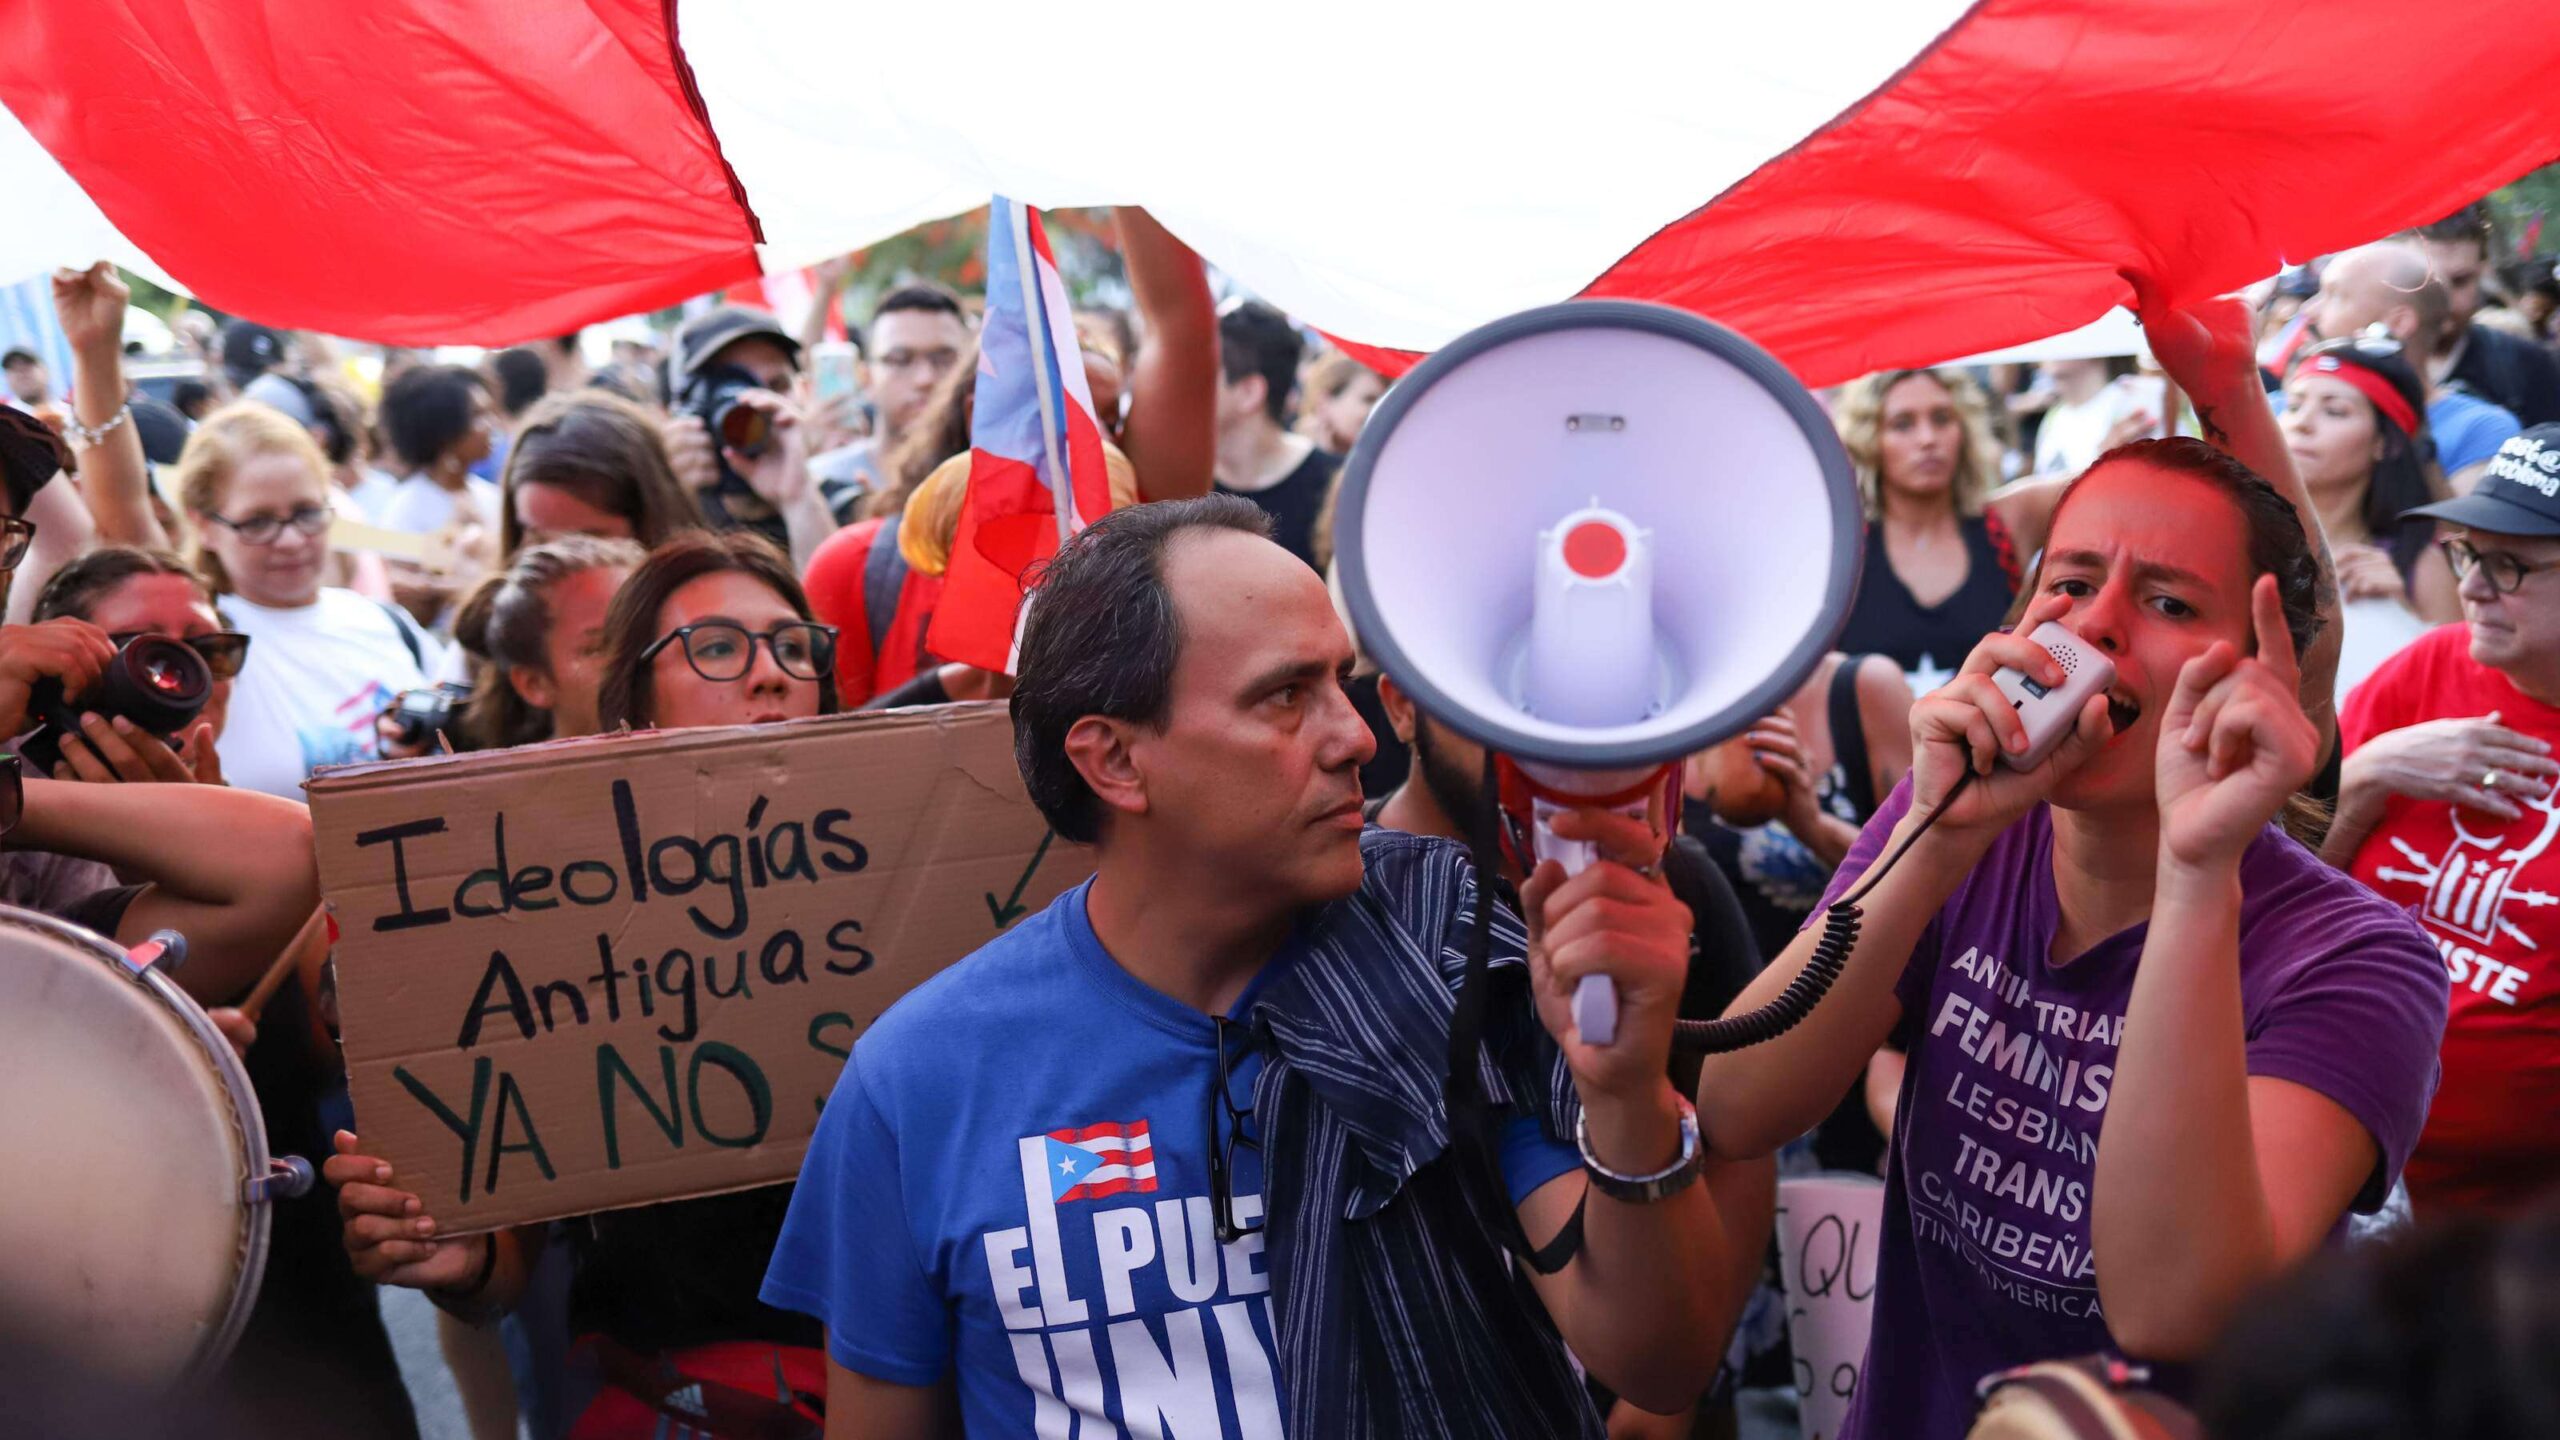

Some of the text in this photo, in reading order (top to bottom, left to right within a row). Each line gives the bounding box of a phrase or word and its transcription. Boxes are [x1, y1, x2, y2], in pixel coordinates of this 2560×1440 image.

[355, 779, 869, 939] Ideologías
[457, 920, 875, 1048] Antiguas
[394, 1056, 556, 1203] YA
[597, 1040, 773, 1170] NO
[1953, 1133, 2086, 1222] TRANS
[983, 1134, 1090, 1330] EL
